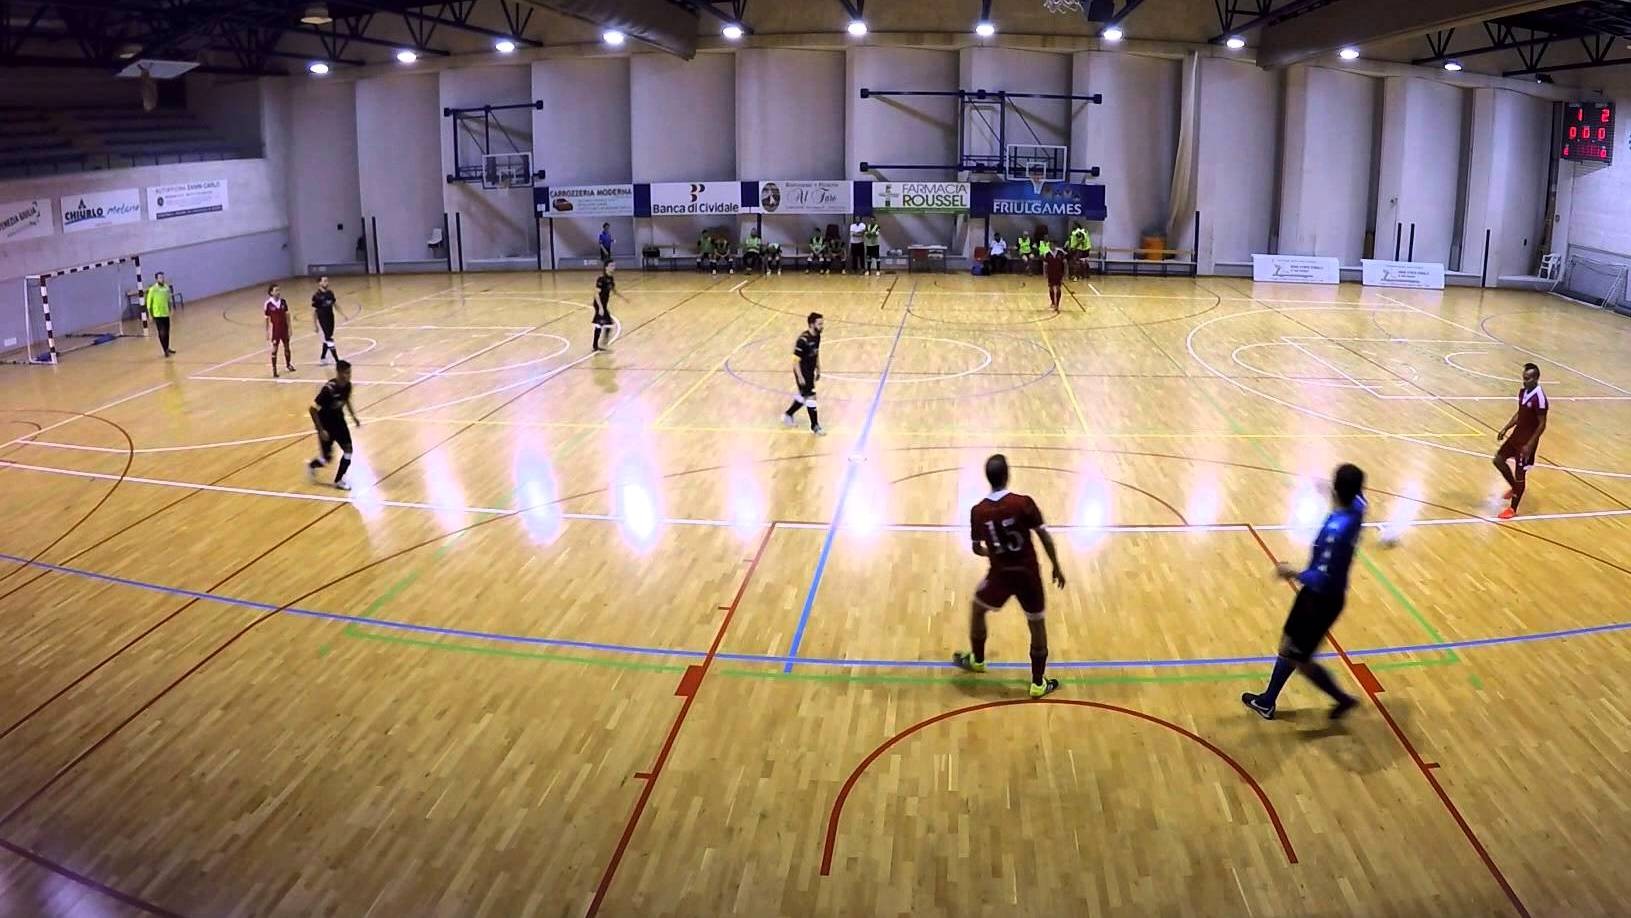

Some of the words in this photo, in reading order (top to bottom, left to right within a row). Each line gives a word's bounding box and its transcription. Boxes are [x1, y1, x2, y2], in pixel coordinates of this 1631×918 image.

[550, 189, 595, 198] CARROZZERIA
[597, 188, 632, 196] MODERNA
[902, 184, 968, 194] FARMACIA
[903, 194, 967, 207] ROUSSEL
[64, 207, 104, 221] CHIURLO
[653, 204, 686, 214] Banca
[687, 203, 698, 213] di
[699, 202, 740, 213] Cividale
[993, 201, 1082, 215] FRIULGAMES
[984, 518, 1024, 554] 15
